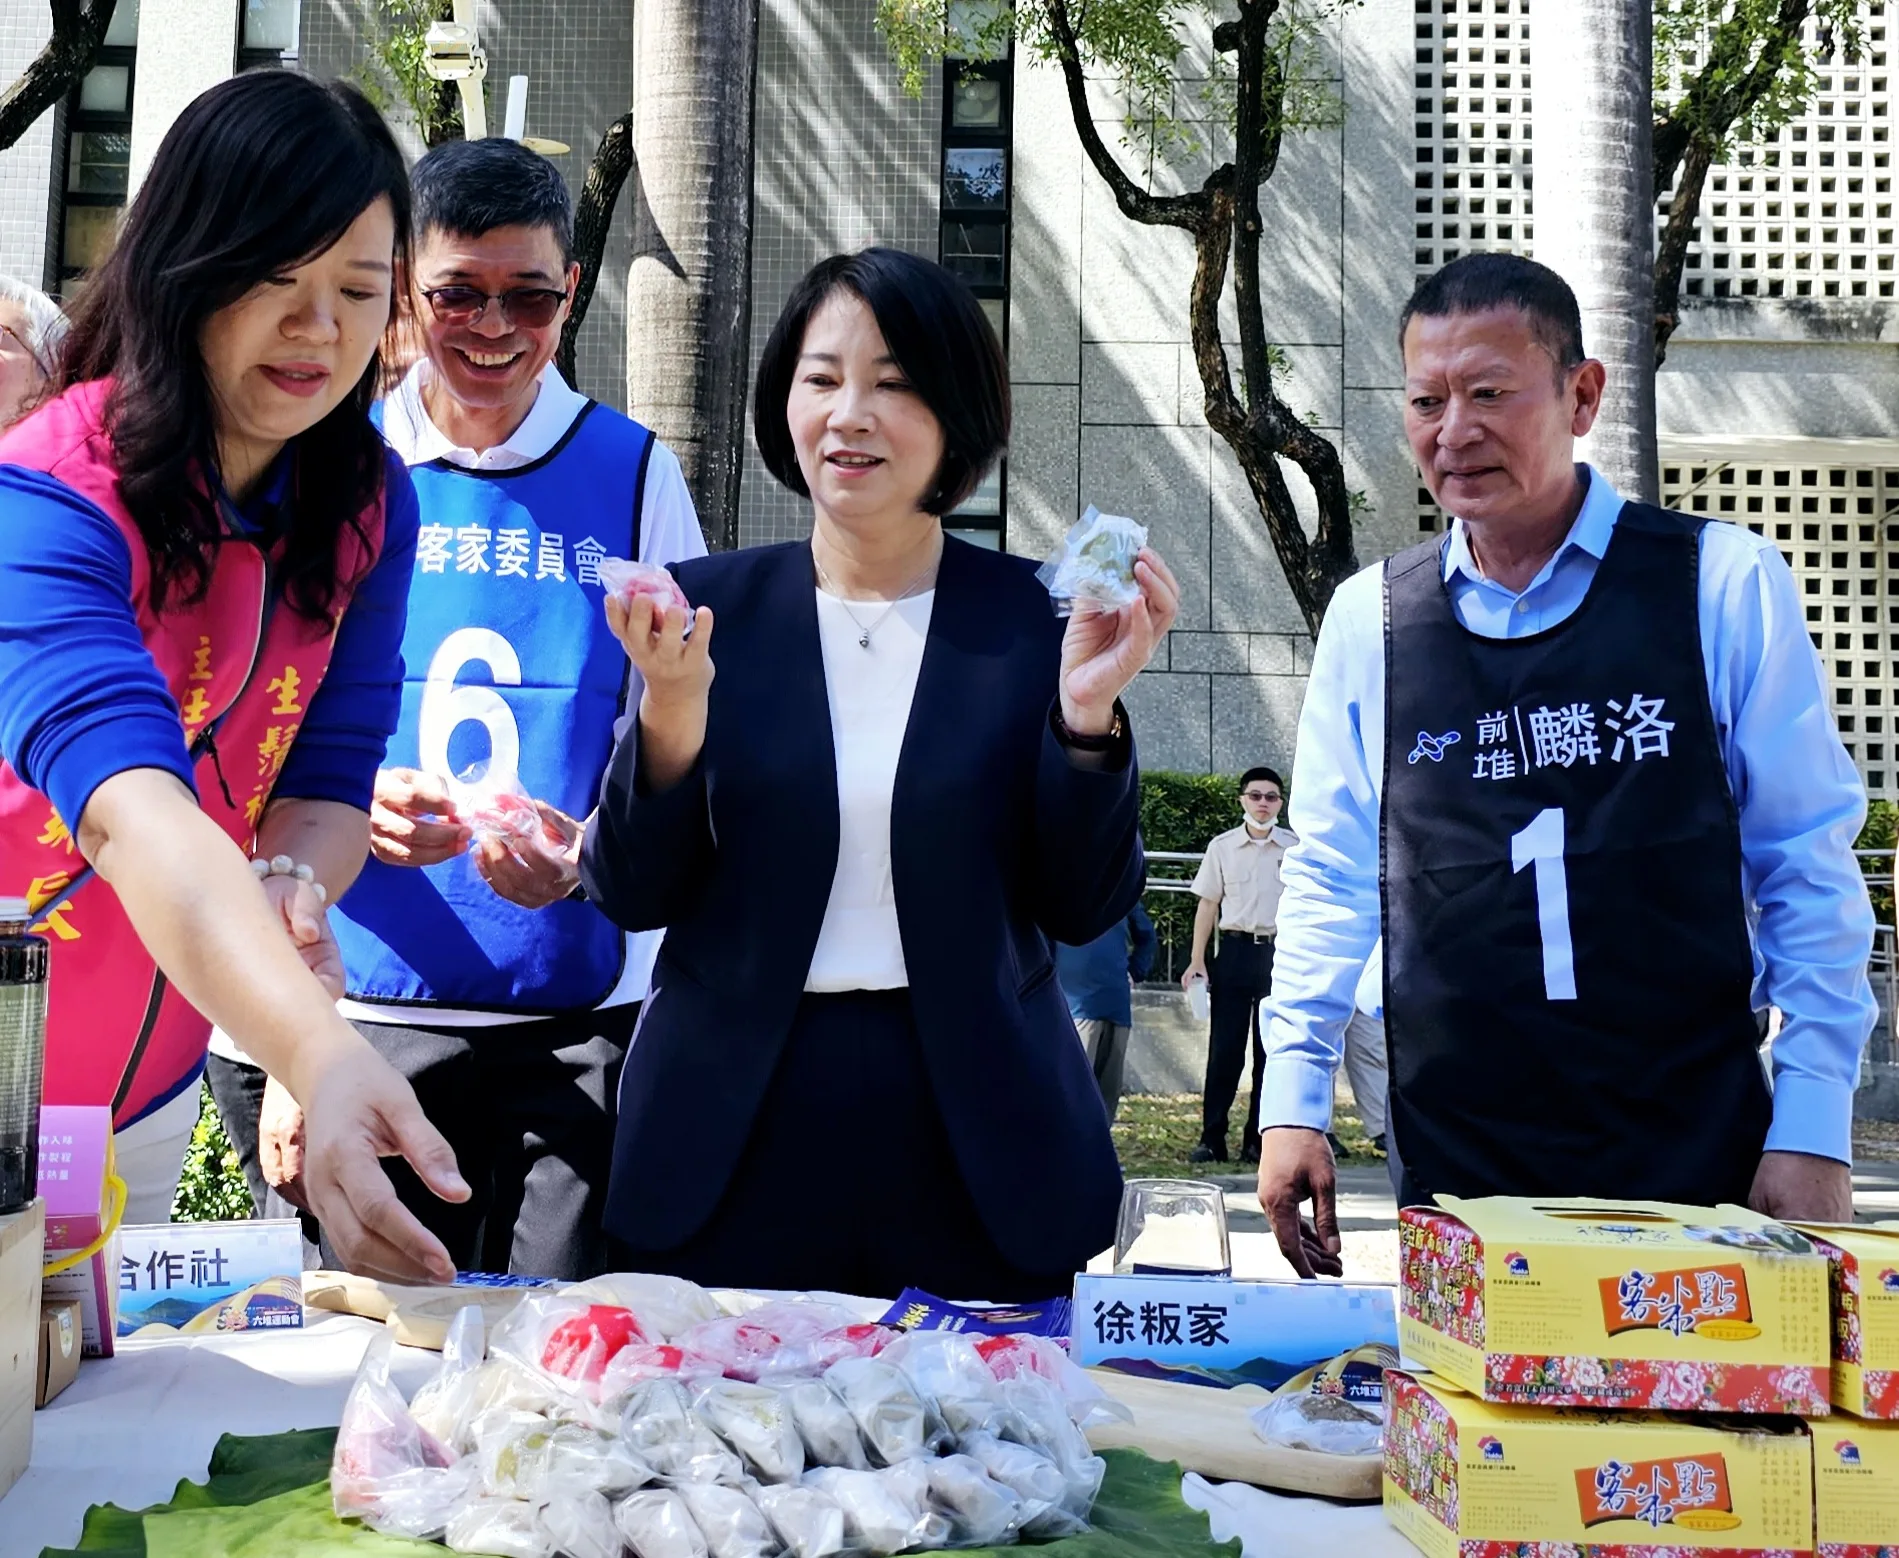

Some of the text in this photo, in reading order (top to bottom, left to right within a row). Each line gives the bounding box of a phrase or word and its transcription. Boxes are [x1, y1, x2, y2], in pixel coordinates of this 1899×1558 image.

[415, 522, 607, 587] 客家委員會
[418, 627, 522, 805] 6
[1528, 693, 1676, 769] 麟洛
[1511, 807, 1578, 1001] 1
[119, 1247, 231, 1292] 合作社
[1093, 1299, 1230, 1347] 徐粄家
[1350, 1384, 1383, 1397] 六堆運
